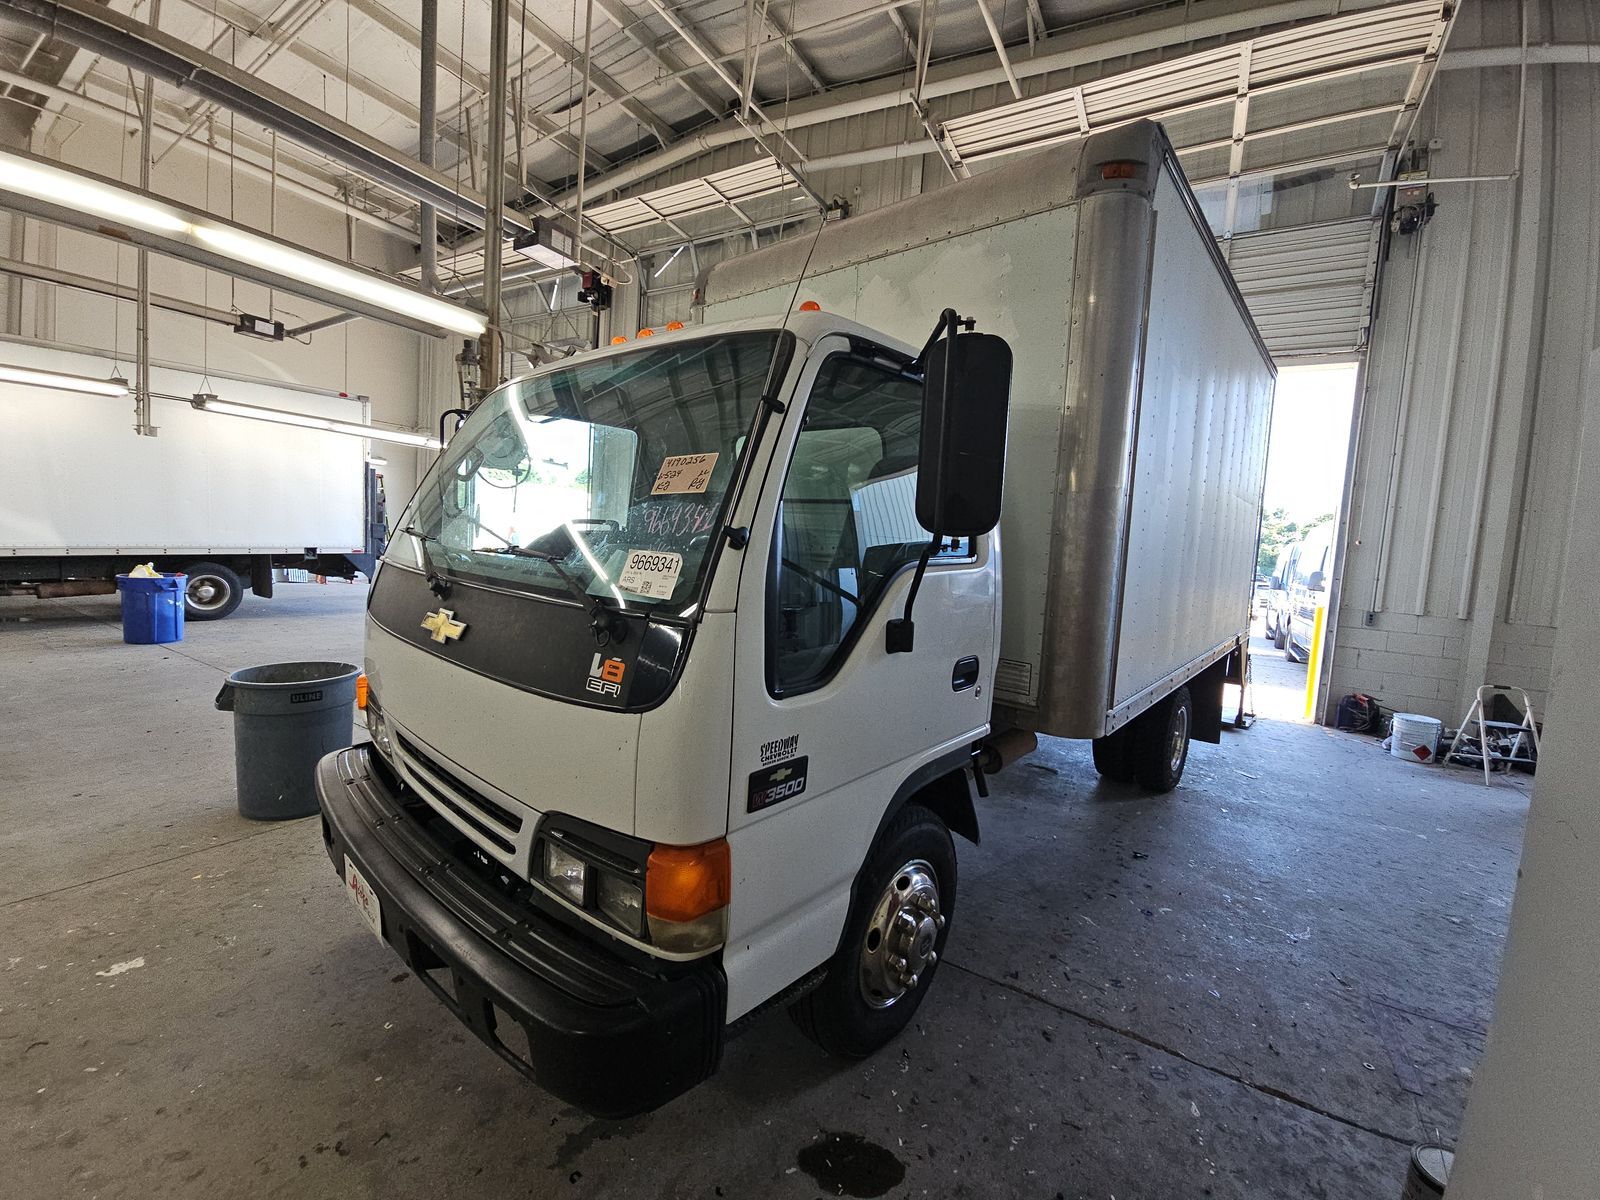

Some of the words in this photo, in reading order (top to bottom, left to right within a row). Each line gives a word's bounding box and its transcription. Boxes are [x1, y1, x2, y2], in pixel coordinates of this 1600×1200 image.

[630, 554, 680, 573] 9669341
[590, 652, 625, 683] V8
[760, 734, 799, 757] SPEEDWAY
[760, 746, 798, 763] CHEVROLET
